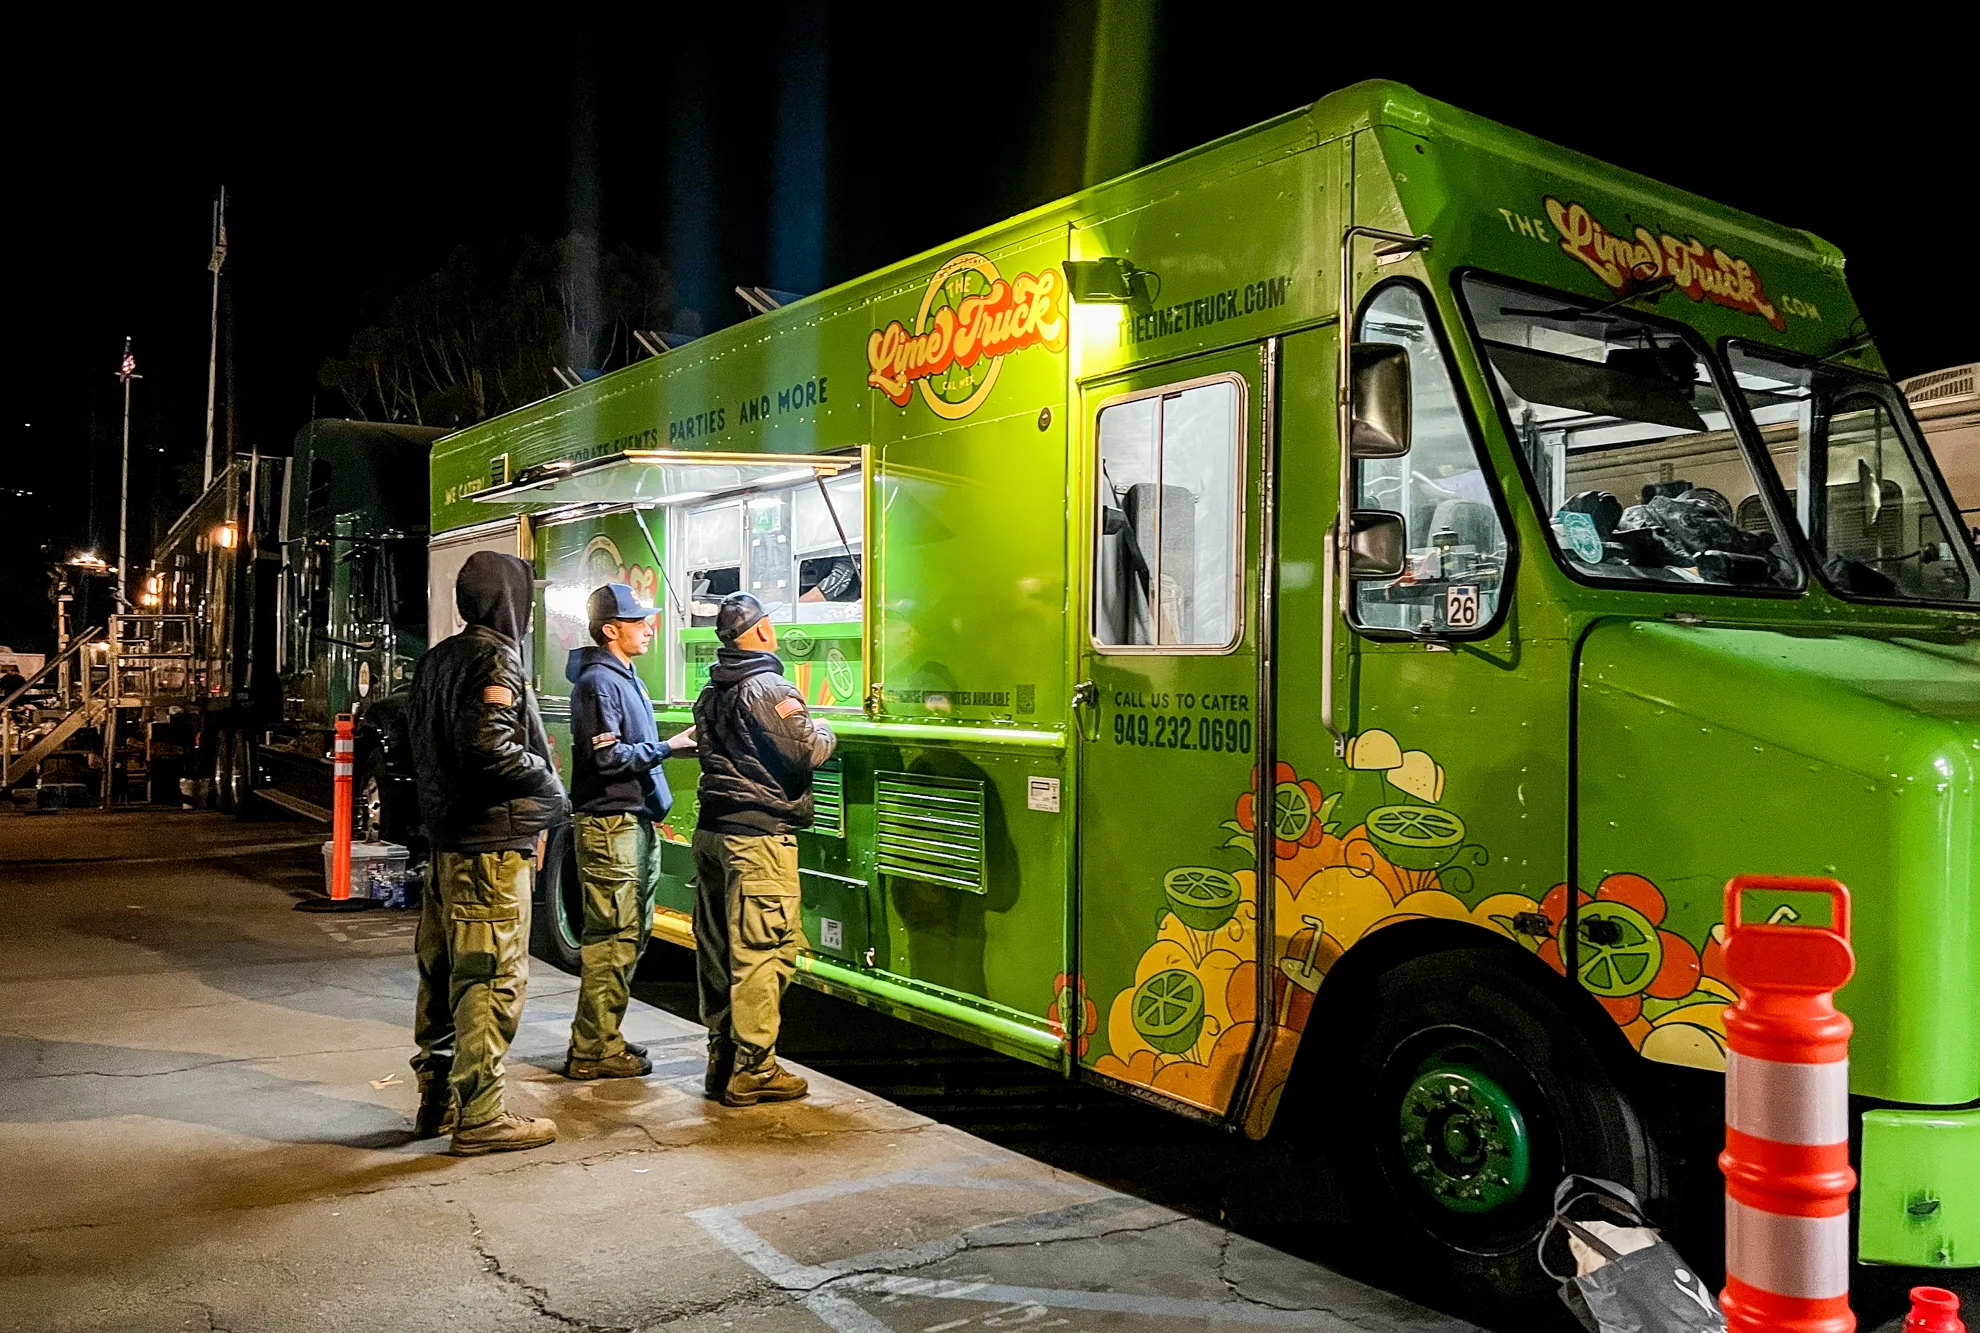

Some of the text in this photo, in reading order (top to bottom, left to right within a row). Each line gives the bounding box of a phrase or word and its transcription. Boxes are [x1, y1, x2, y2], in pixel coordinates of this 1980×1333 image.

[1498, 207, 1550, 243] THE
[1545, 198, 1662, 288] Lime
[1660, 234, 1776, 320] Truck
[946, 276, 972, 299] THE
[867, 272, 1062, 397] Lime Truck
[942, 375, 975, 391] CAL MEX
[669, 408, 725, 444] PARTIES
[739, 395, 771, 426] AND
[778, 377, 828, 414] MORE
[1449, 596, 1475, 624] 26
[1114, 691, 1249, 711] CALL US TO CATER
[1114, 713, 1251, 754] 949.232.0690
